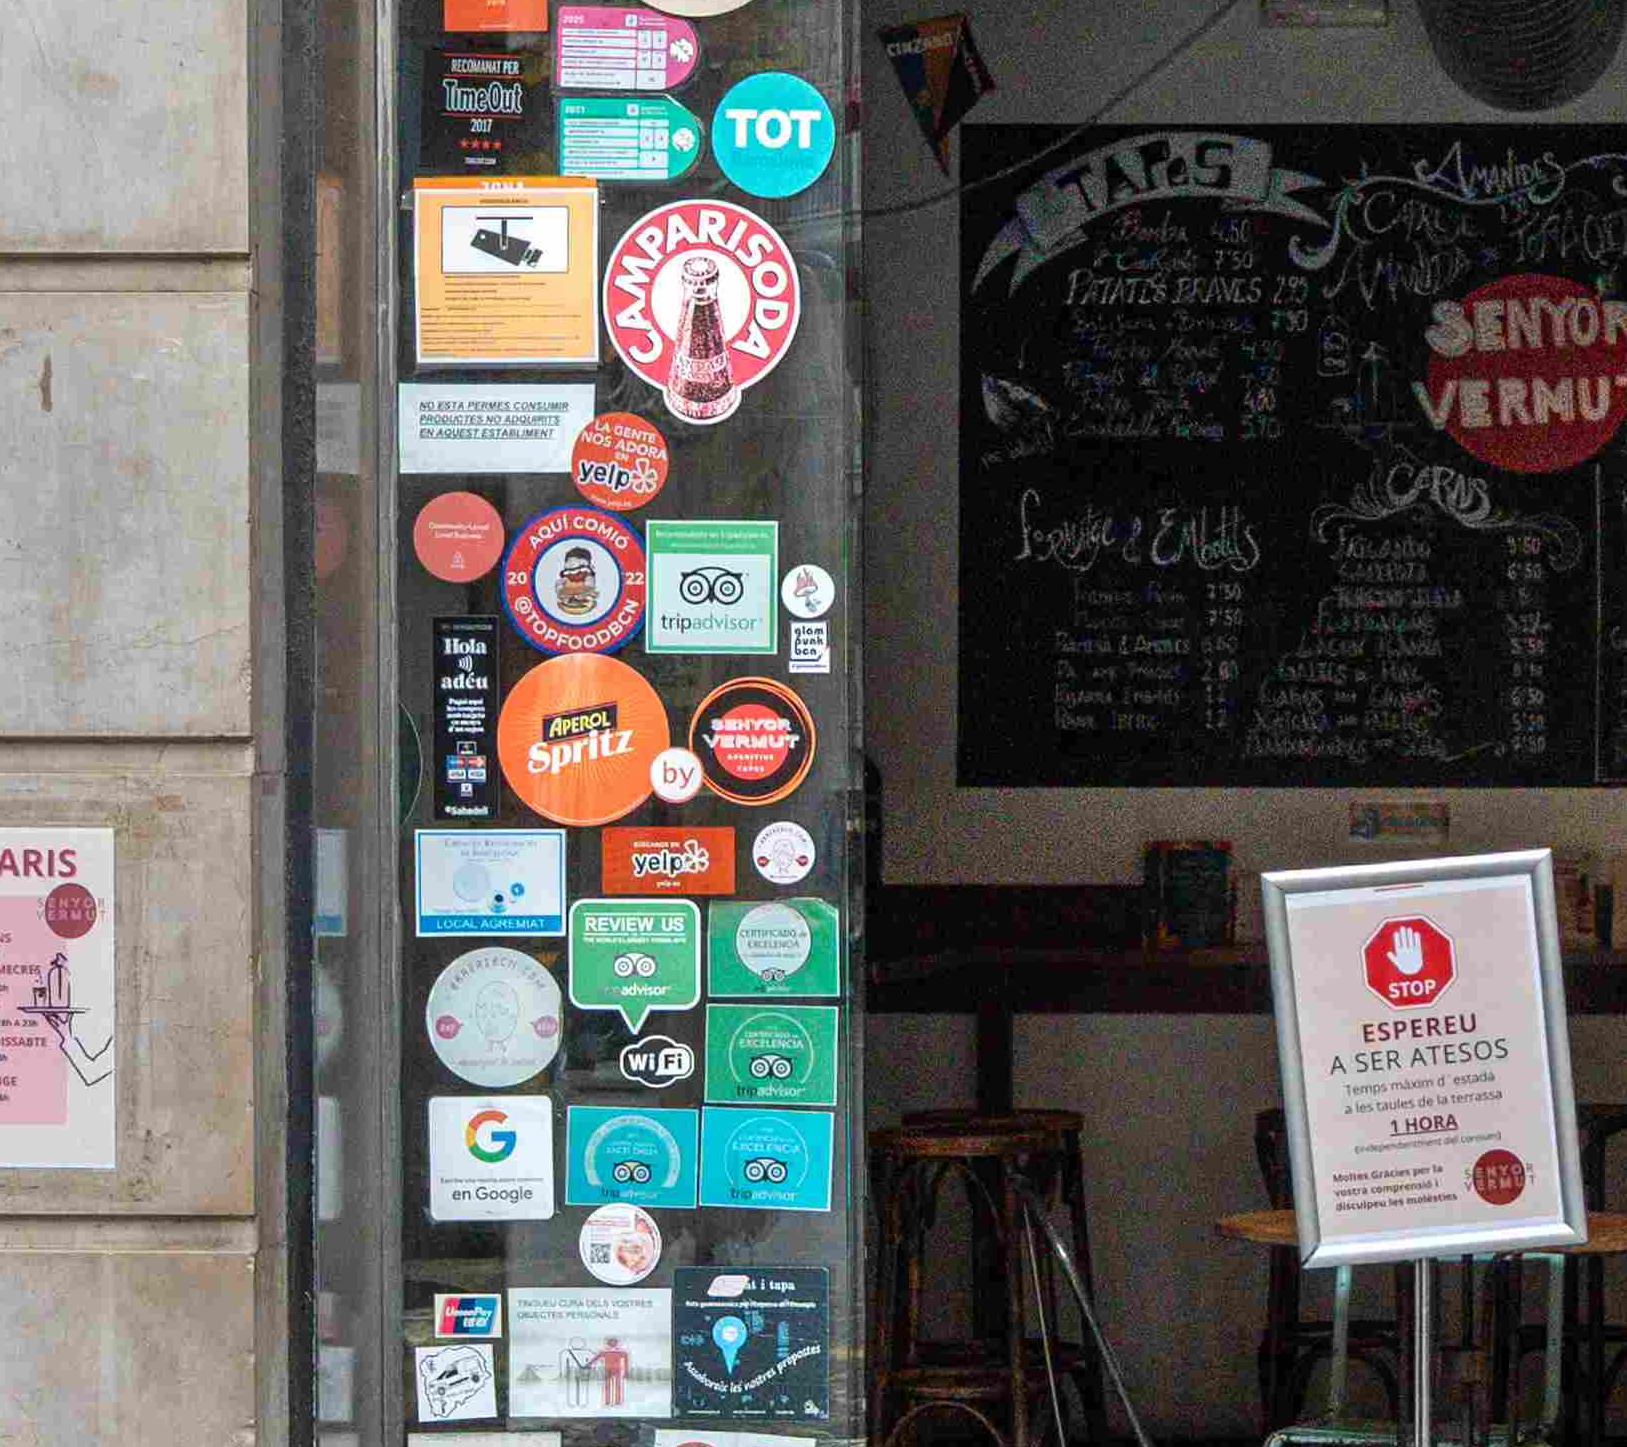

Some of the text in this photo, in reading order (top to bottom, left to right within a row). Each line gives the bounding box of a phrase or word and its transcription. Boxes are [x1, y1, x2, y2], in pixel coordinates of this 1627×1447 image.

[502, 59, 519, 75] PER
[469, 118, 494, 133] 2017
[725, 108, 821, 149] TOT
[595, 420, 656, 444] LA GENTE
[581, 431, 668, 461] NOS ADORA
[578, 458, 631, 492] yelp
[574, 515, 630, 550] COMIÓ
[508, 572, 645, 586] 20 22
[514, 596, 639, 649] @TOPFOODBCN
[660, 612, 758, 635] tripadvisor
[443, 637, 487, 655] Hola
[440, 671, 488, 690] adéu
[547, 708, 612, 741] APEROL
[526, 727, 635, 777] Spritz
[701, 733, 801, 750] VERMUT
[663, 761, 695, 788] by
[632, 849, 685, 878] yelp
[436, 918, 547, 931] LOCAL AGREMIAT
[584, 916, 685, 933] REVIEW US
[1388, 979, 1437, 999] STOP
[1361, 1013, 1477, 1043] ESPEREU
[1330, 1038, 1510, 1076] A SER ATESOS
[1343, 1080, 1389, 1098] Temps
[1417, 1094, 1434, 1109] de
[1436, 1092, 1448, 1106] la
[1450, 1089, 1503, 1106] terrassa
[1390, 1113, 1460, 1134] 1 HORA
[452, 1185, 534, 1204] en Google
